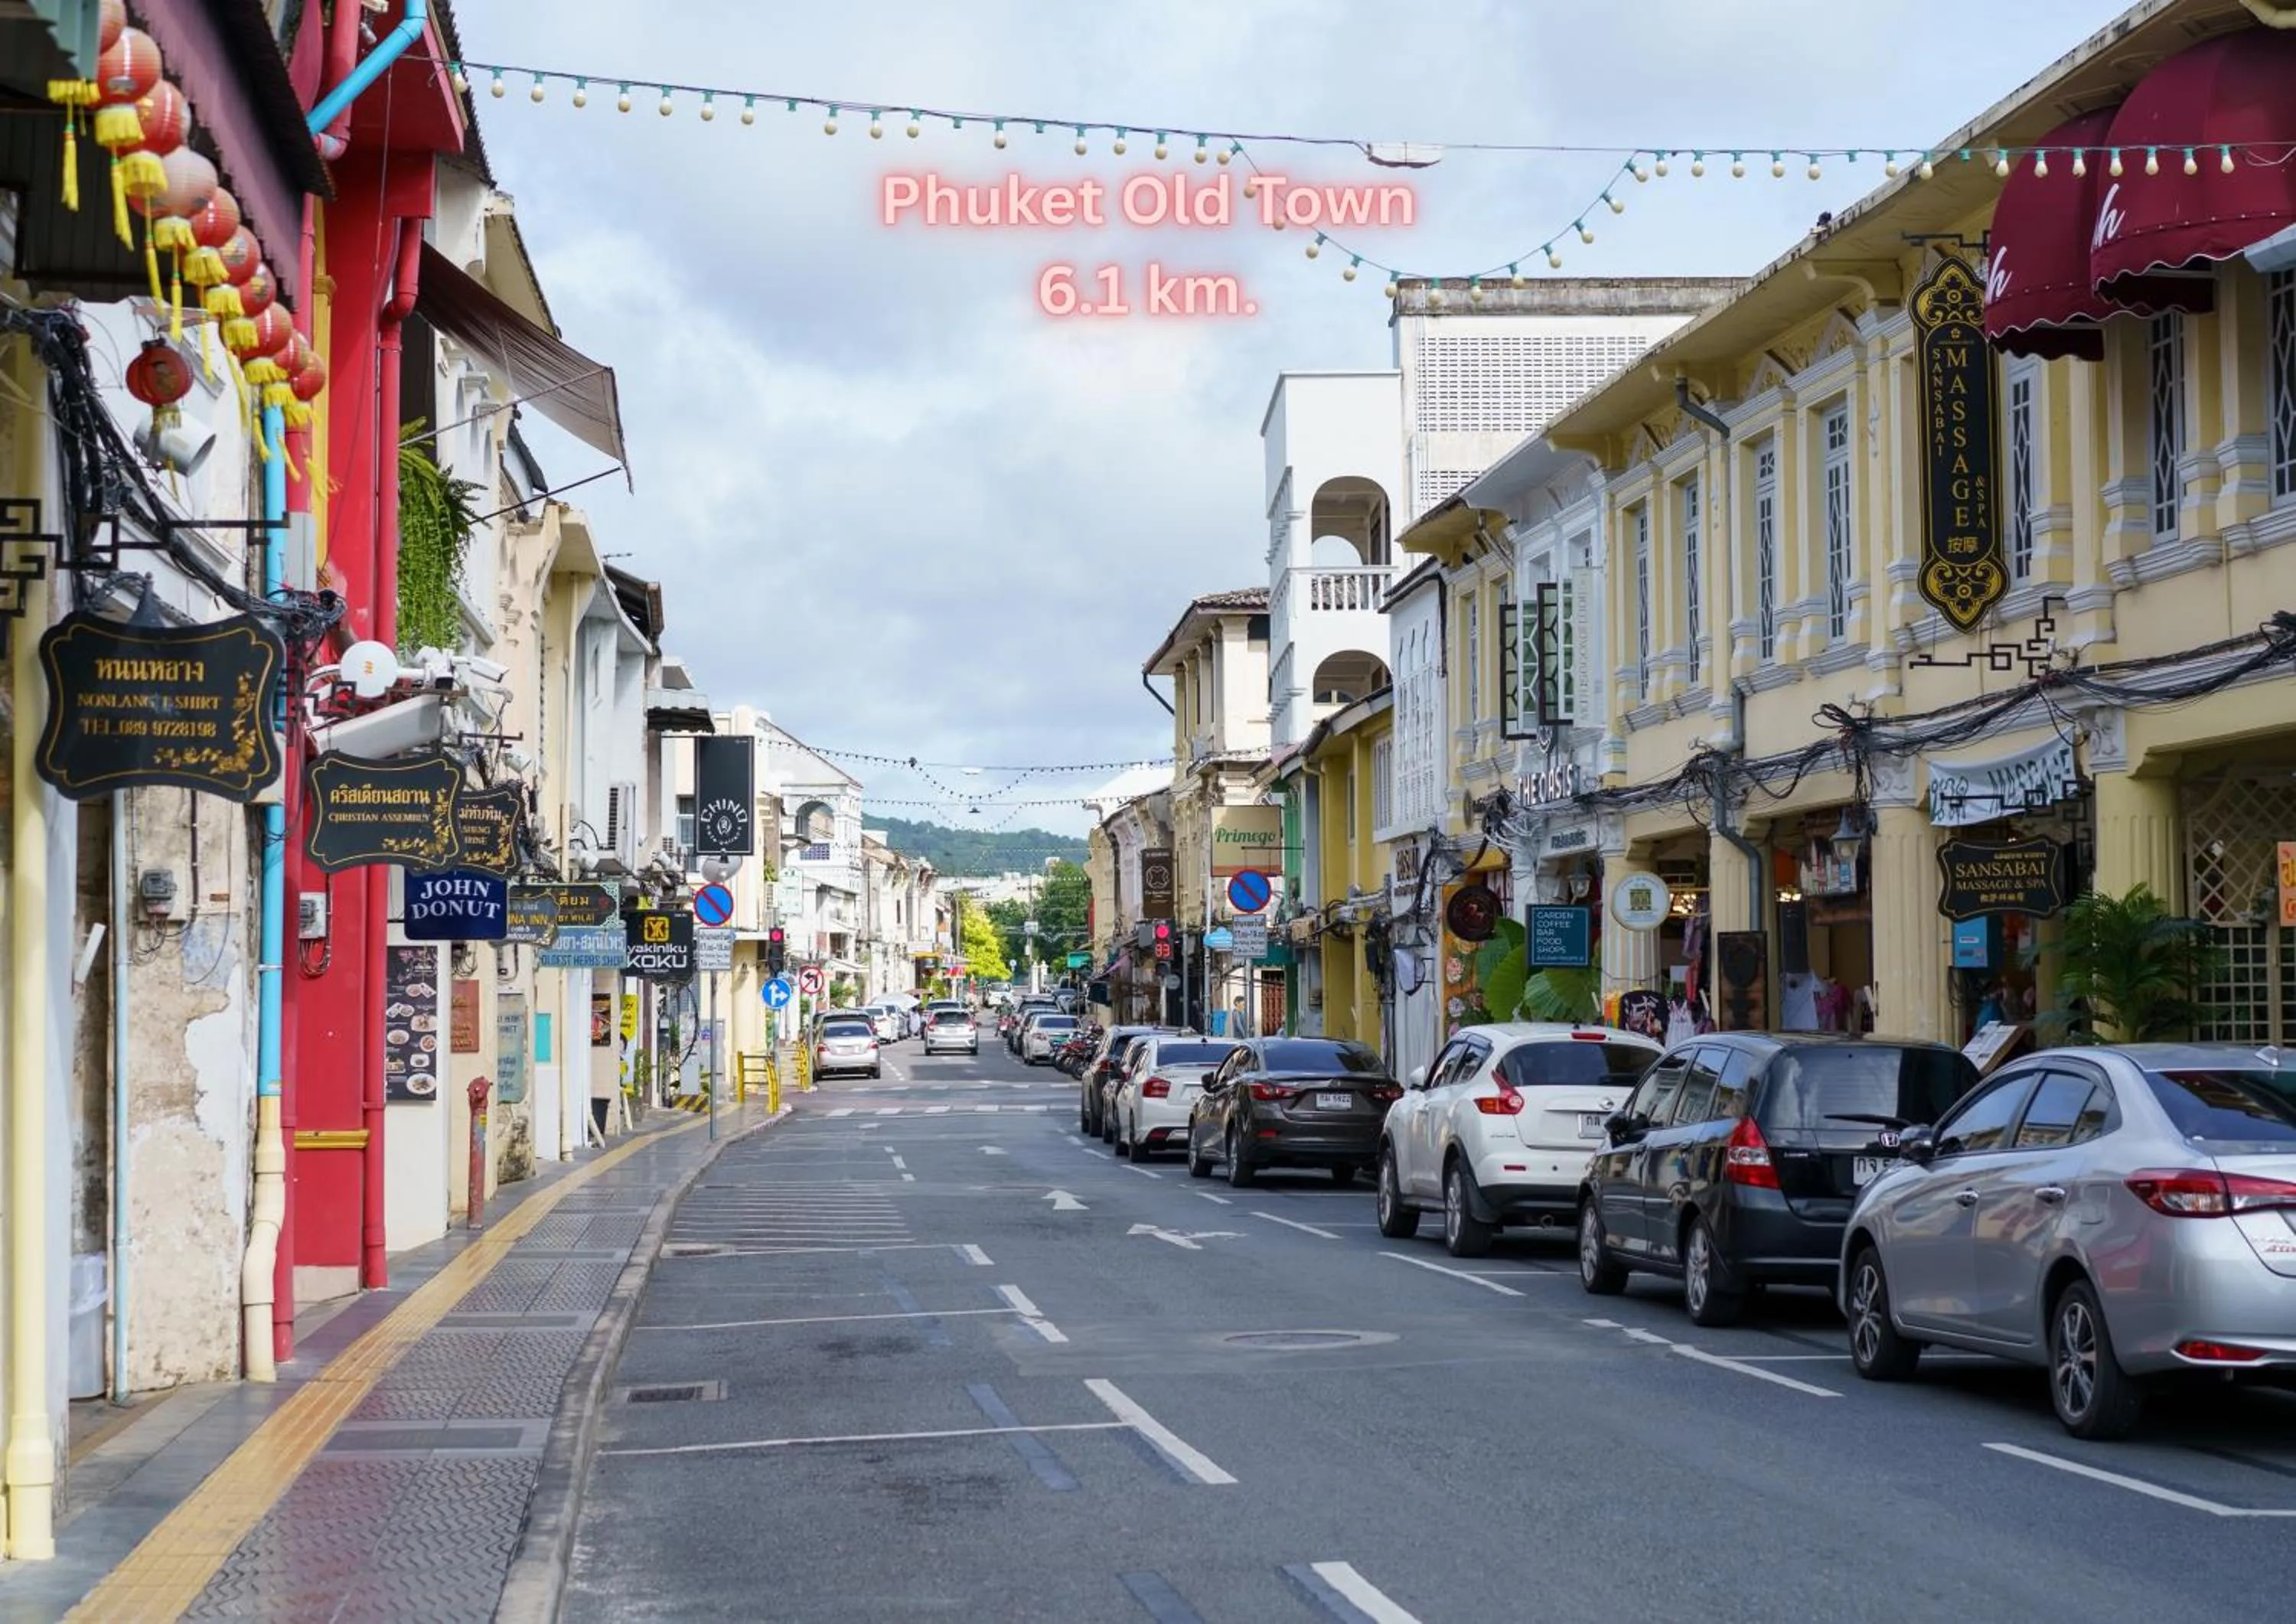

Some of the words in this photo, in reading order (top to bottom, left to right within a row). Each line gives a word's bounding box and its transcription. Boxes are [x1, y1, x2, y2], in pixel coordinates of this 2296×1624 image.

[1932, 348, 1945, 457] SANSABAI
[1945, 347, 1969, 527] MASSAGE
[328, 813, 381, 823] CHRISTIAN
[701, 798, 748, 823] CHINO
[1215, 827, 1276, 846] Primego
[1955, 861, 2045, 878] SANSABAI
[421, 879, 491, 899] JOHN
[1955, 879, 2013, 891] MASSAGE
[2014, 879, 2024, 889] &
[2026, 878, 2047, 889] SPA
[410, 899, 501, 919] DONUT
[627, 943, 687, 954] yakiniku
[627, 954, 687, 968] KOKU
